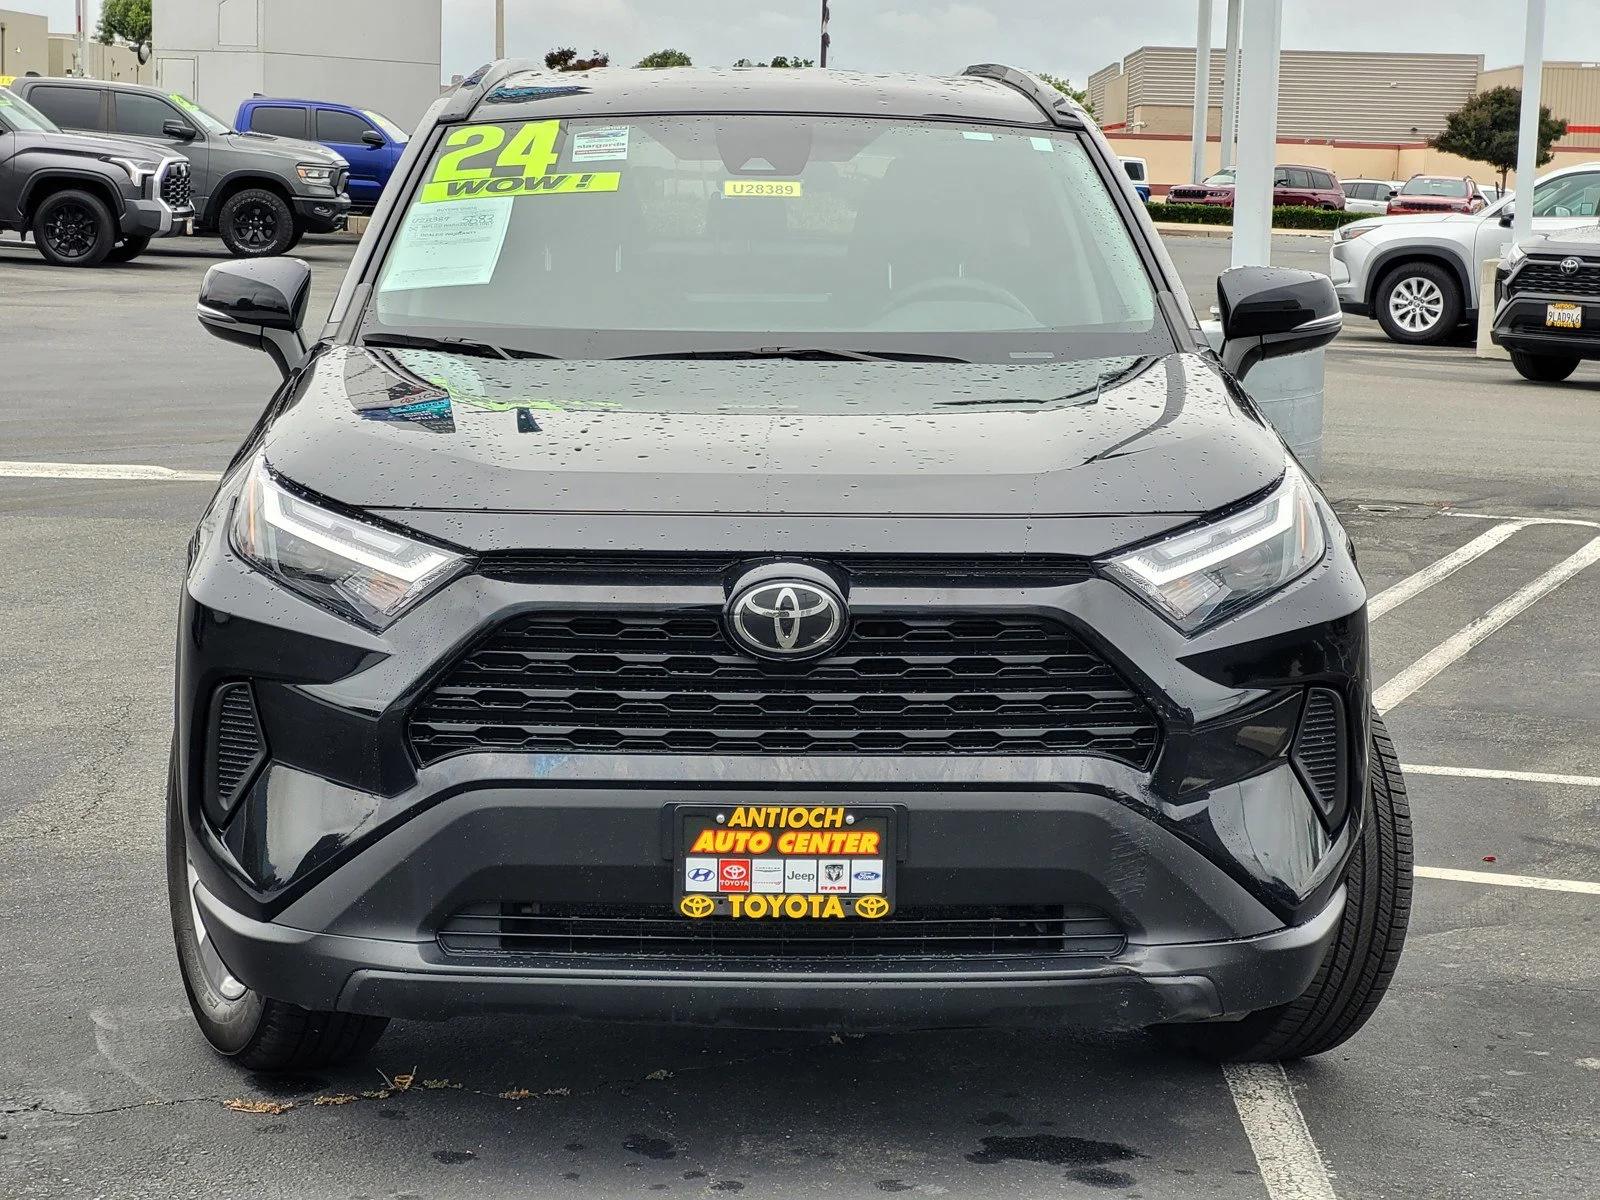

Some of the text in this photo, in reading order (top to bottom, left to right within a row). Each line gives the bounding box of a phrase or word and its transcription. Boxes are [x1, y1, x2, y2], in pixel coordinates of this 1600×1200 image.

[434, 120, 560, 182] 24
[447, 175, 569, 195] WOW
[733, 184, 794, 194] U28389
[727, 807, 845, 828] ANTIOCH
[691, 830, 881, 855] AUTO CENTER
[720, 879, 750, 887] TOYOTA
[787, 870, 815, 882] Jeep
[857, 872, 876, 880] Ford
[727, 894, 845, 919] TOYOTA
